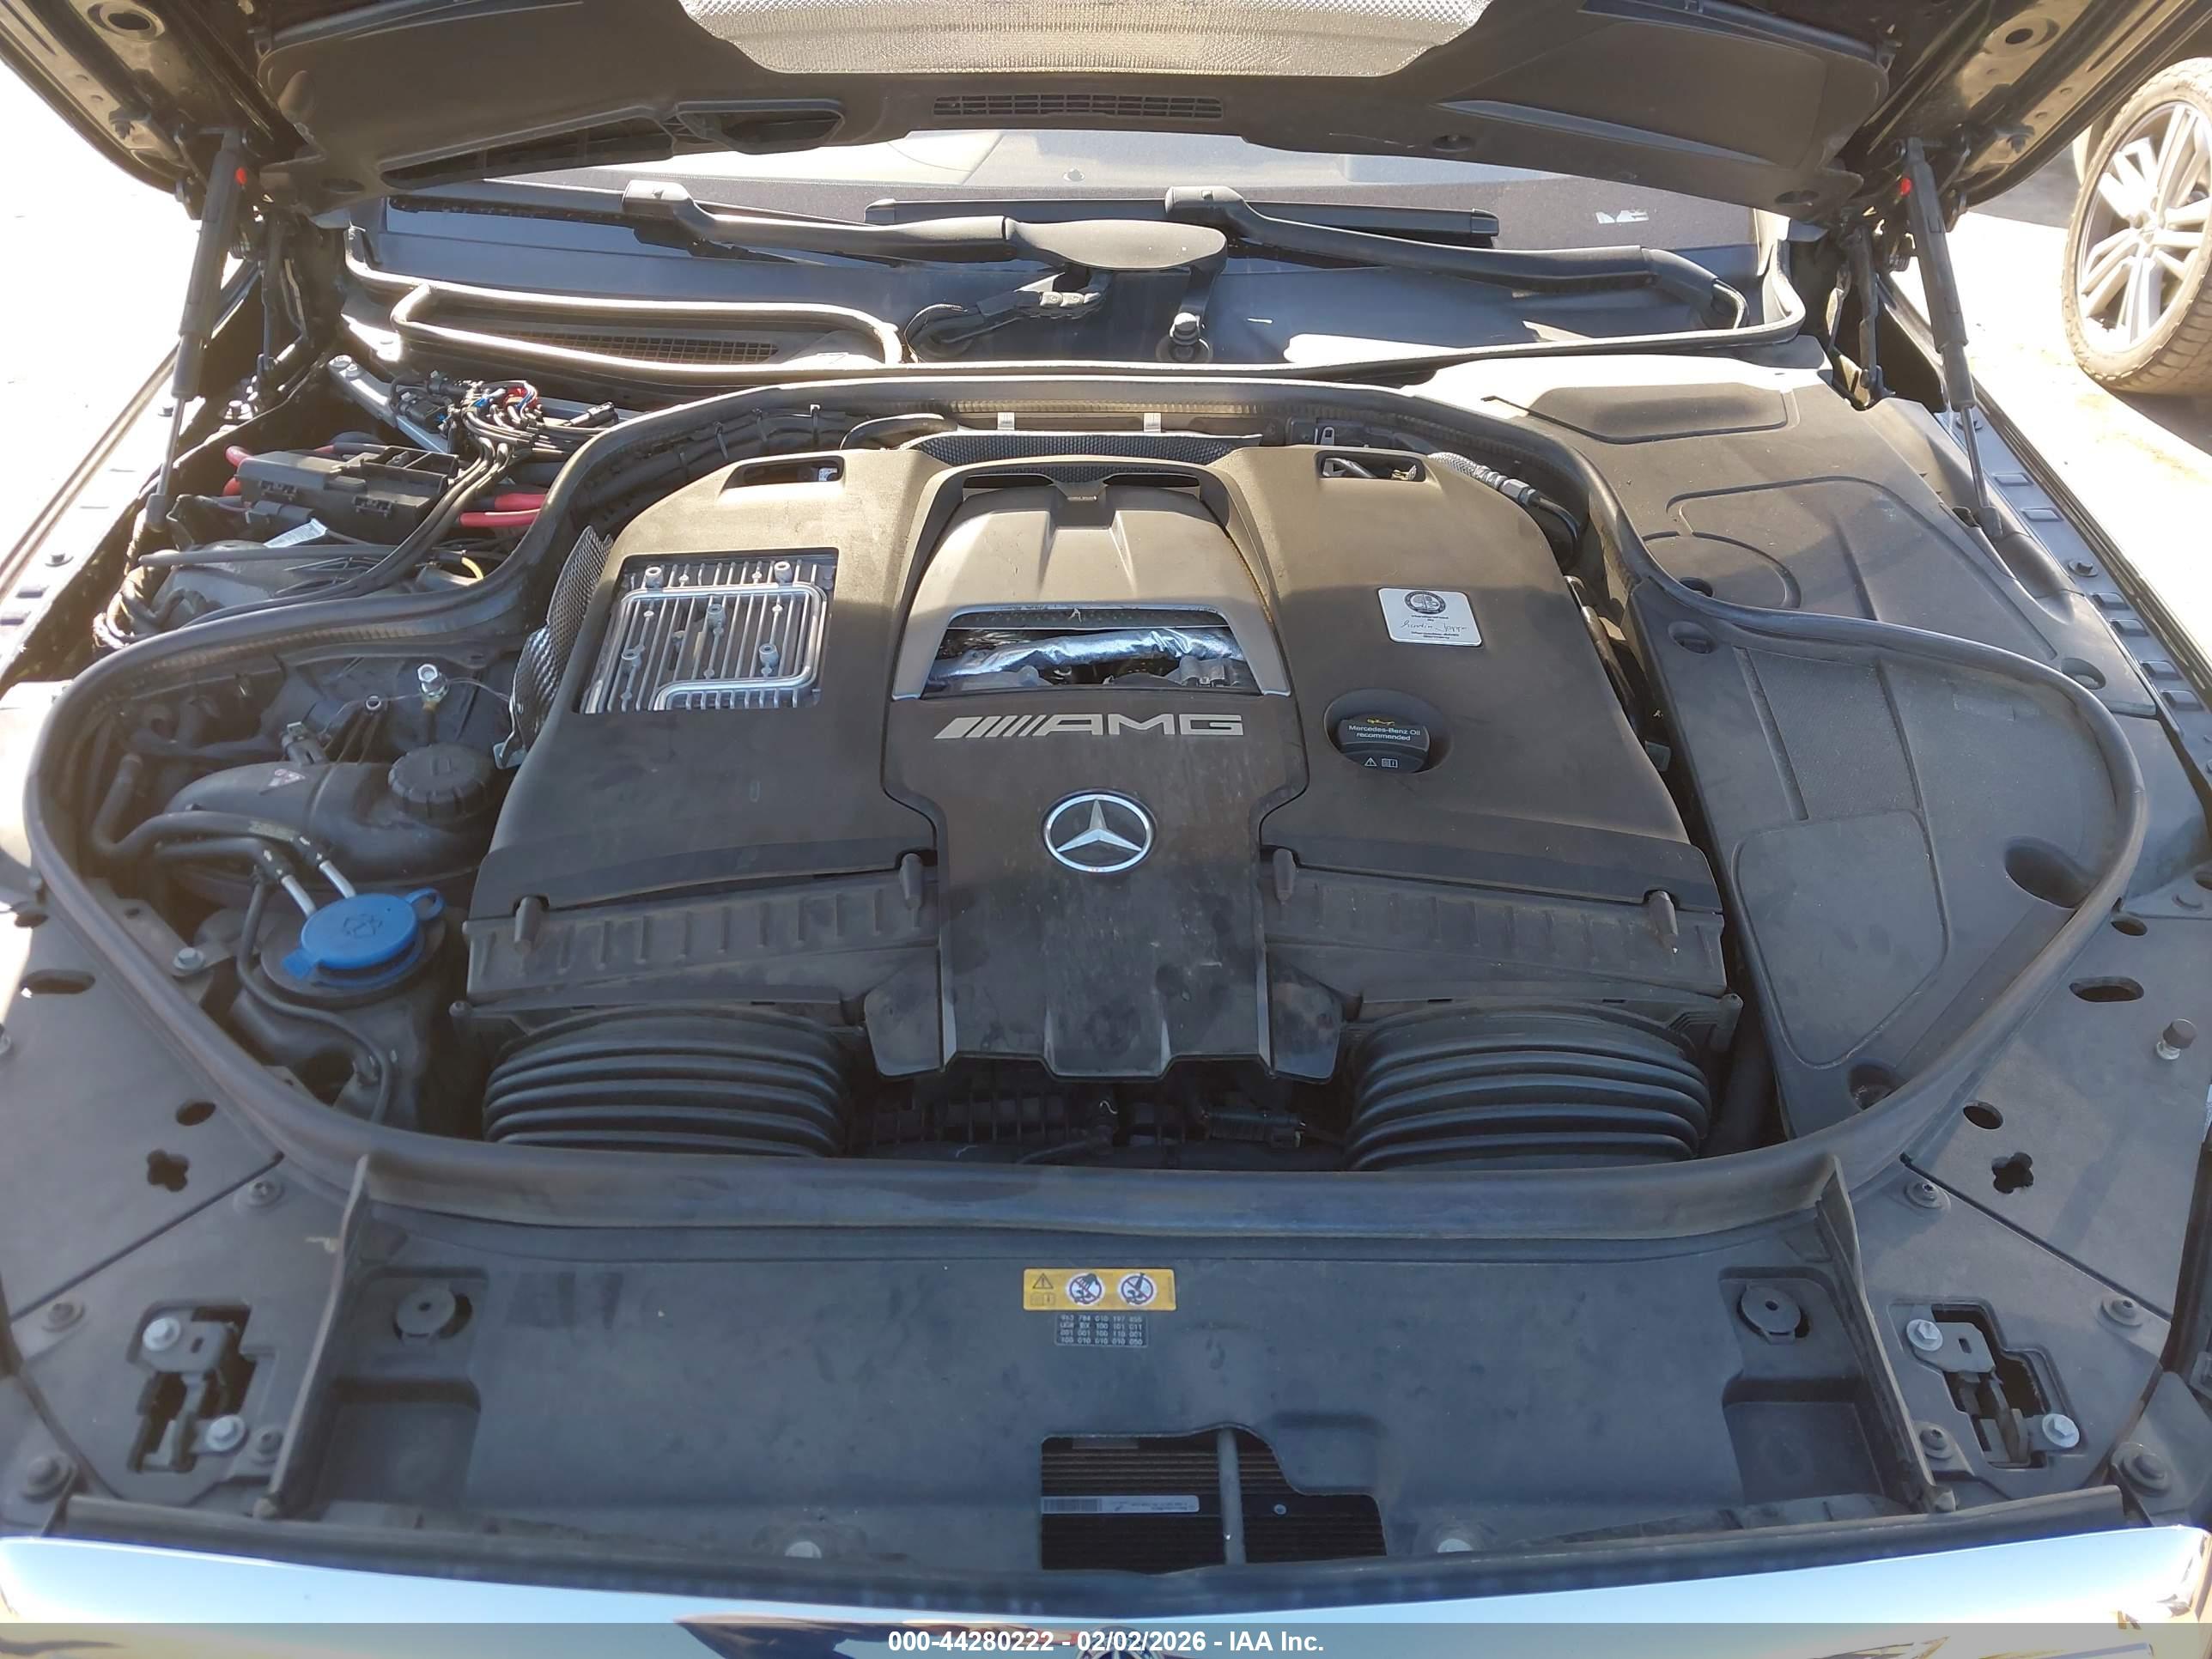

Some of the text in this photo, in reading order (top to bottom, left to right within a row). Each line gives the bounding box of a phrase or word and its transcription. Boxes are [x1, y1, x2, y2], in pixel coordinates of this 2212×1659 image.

[1031, 713, 1244, 737] AMG
[1348, 725, 1408, 735] Mercedes-Benz
[1356, 732, 1411, 741] recommended
